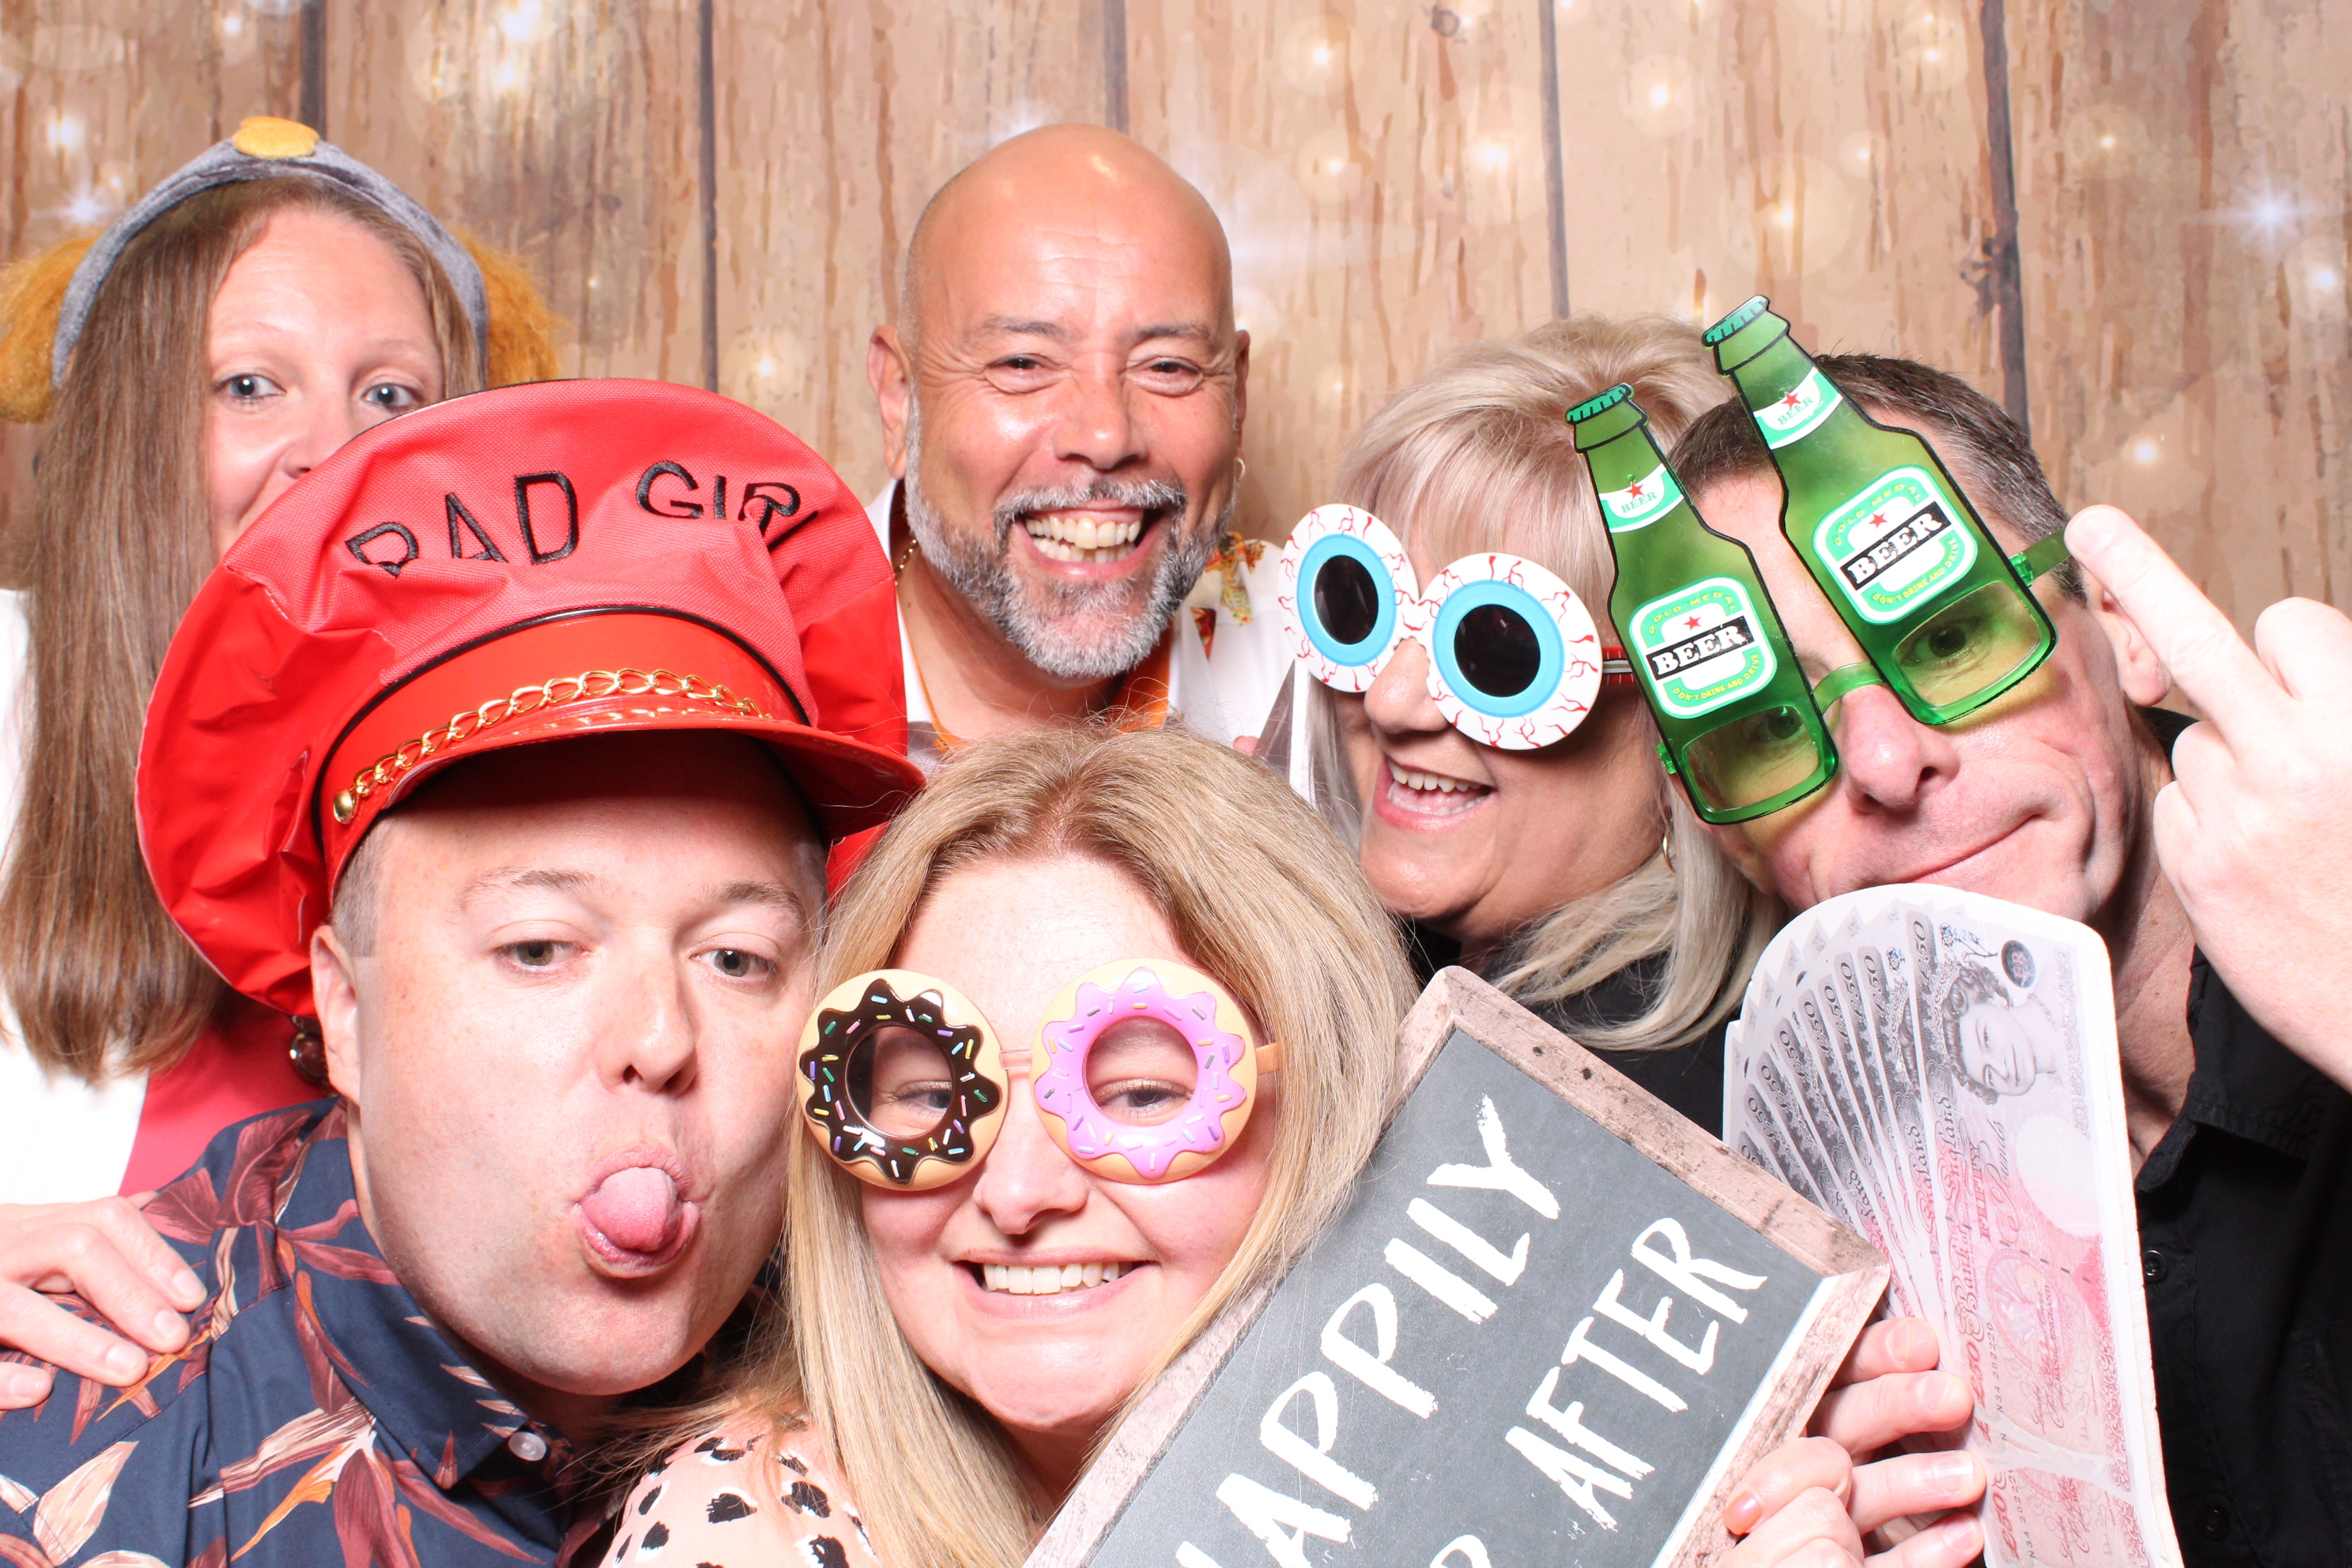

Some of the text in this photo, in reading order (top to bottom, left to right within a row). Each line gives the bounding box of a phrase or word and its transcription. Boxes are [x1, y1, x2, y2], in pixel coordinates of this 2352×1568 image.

[1776, 396, 1814, 426] BEER
[1620, 491, 1658, 514] BEER
[1831, 483, 1922, 546] GOLD MEDAL
[1847, 513, 1942, 584] BEER
[1872, 537, 1959, 604] DON'T DRINK AND DRIVE
[1648, 591, 1737, 635] GOLD MEDAL
[1652, 625, 1746, 675] BEER
[1671, 653, 1761, 702] DON'T DRINK AND DRIVE
[1912, 919, 1931, 981] £50
[1742, 1144, 1764, 1170] 50
[1968, 1136, 1991, 1242] FIFTY
[1176, 1093, 1560, 1568] APPILY
[1505, 1217, 1769, 1532] AFTER
[1966, 1340, 1986, 1409] £50
[1985, 1322, 2004, 1414] N34 202220
[1993, 1492, 2020, 1561] £50
[2024, 1531, 2036, 1558] N34
